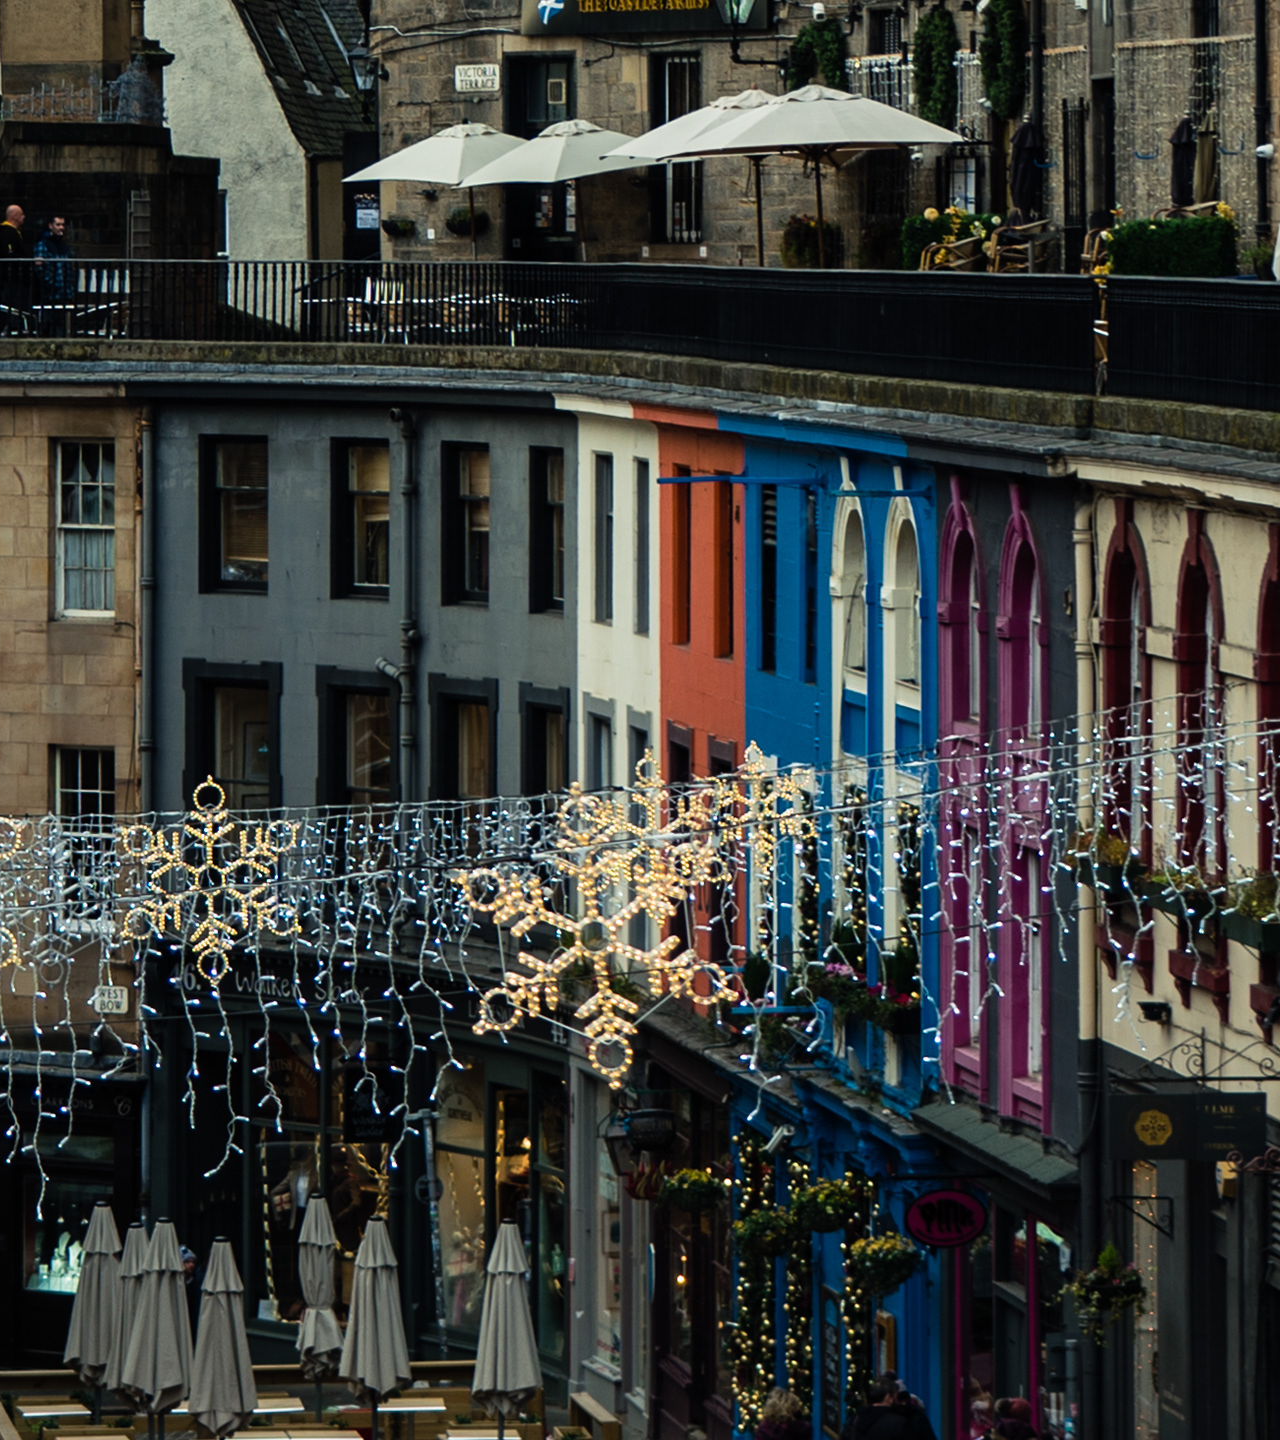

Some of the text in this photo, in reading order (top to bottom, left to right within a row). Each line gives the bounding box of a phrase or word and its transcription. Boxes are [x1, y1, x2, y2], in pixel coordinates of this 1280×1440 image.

[458, 66, 497, 78] VICTORIA
[460, 79, 496, 90] TERRACE
[31, 1096, 94, 1110] CARKONS
